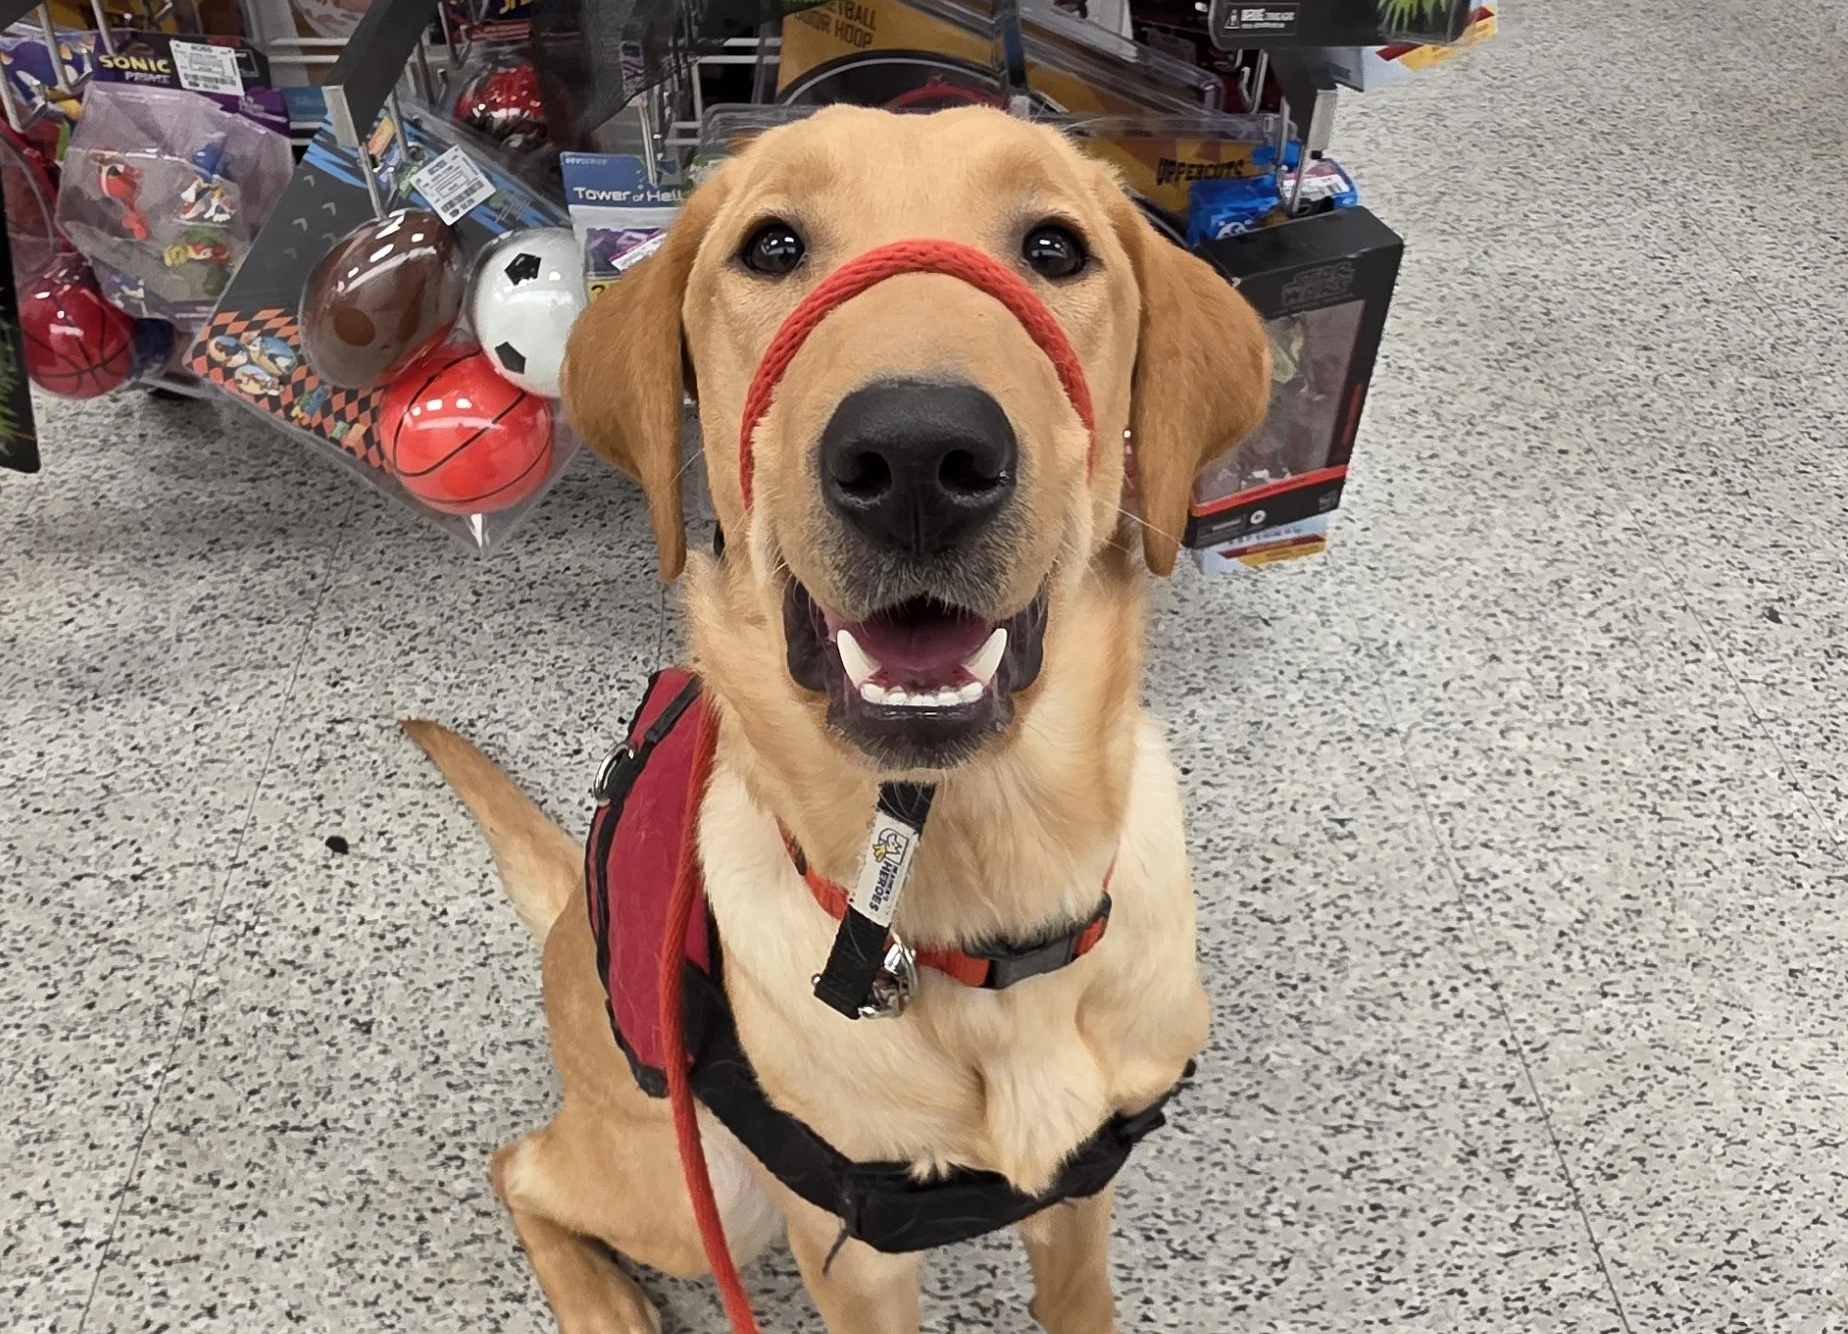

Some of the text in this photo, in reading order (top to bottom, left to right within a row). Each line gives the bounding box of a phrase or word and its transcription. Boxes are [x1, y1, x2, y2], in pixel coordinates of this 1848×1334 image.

[834, 18, 874, 49] HOOP
[98, 55, 171, 74] SONIC
[125, 70, 171, 84] PRIME
[573, 185, 685, 203] Tower of Hell
[869, 860, 893, 912] HEROES
